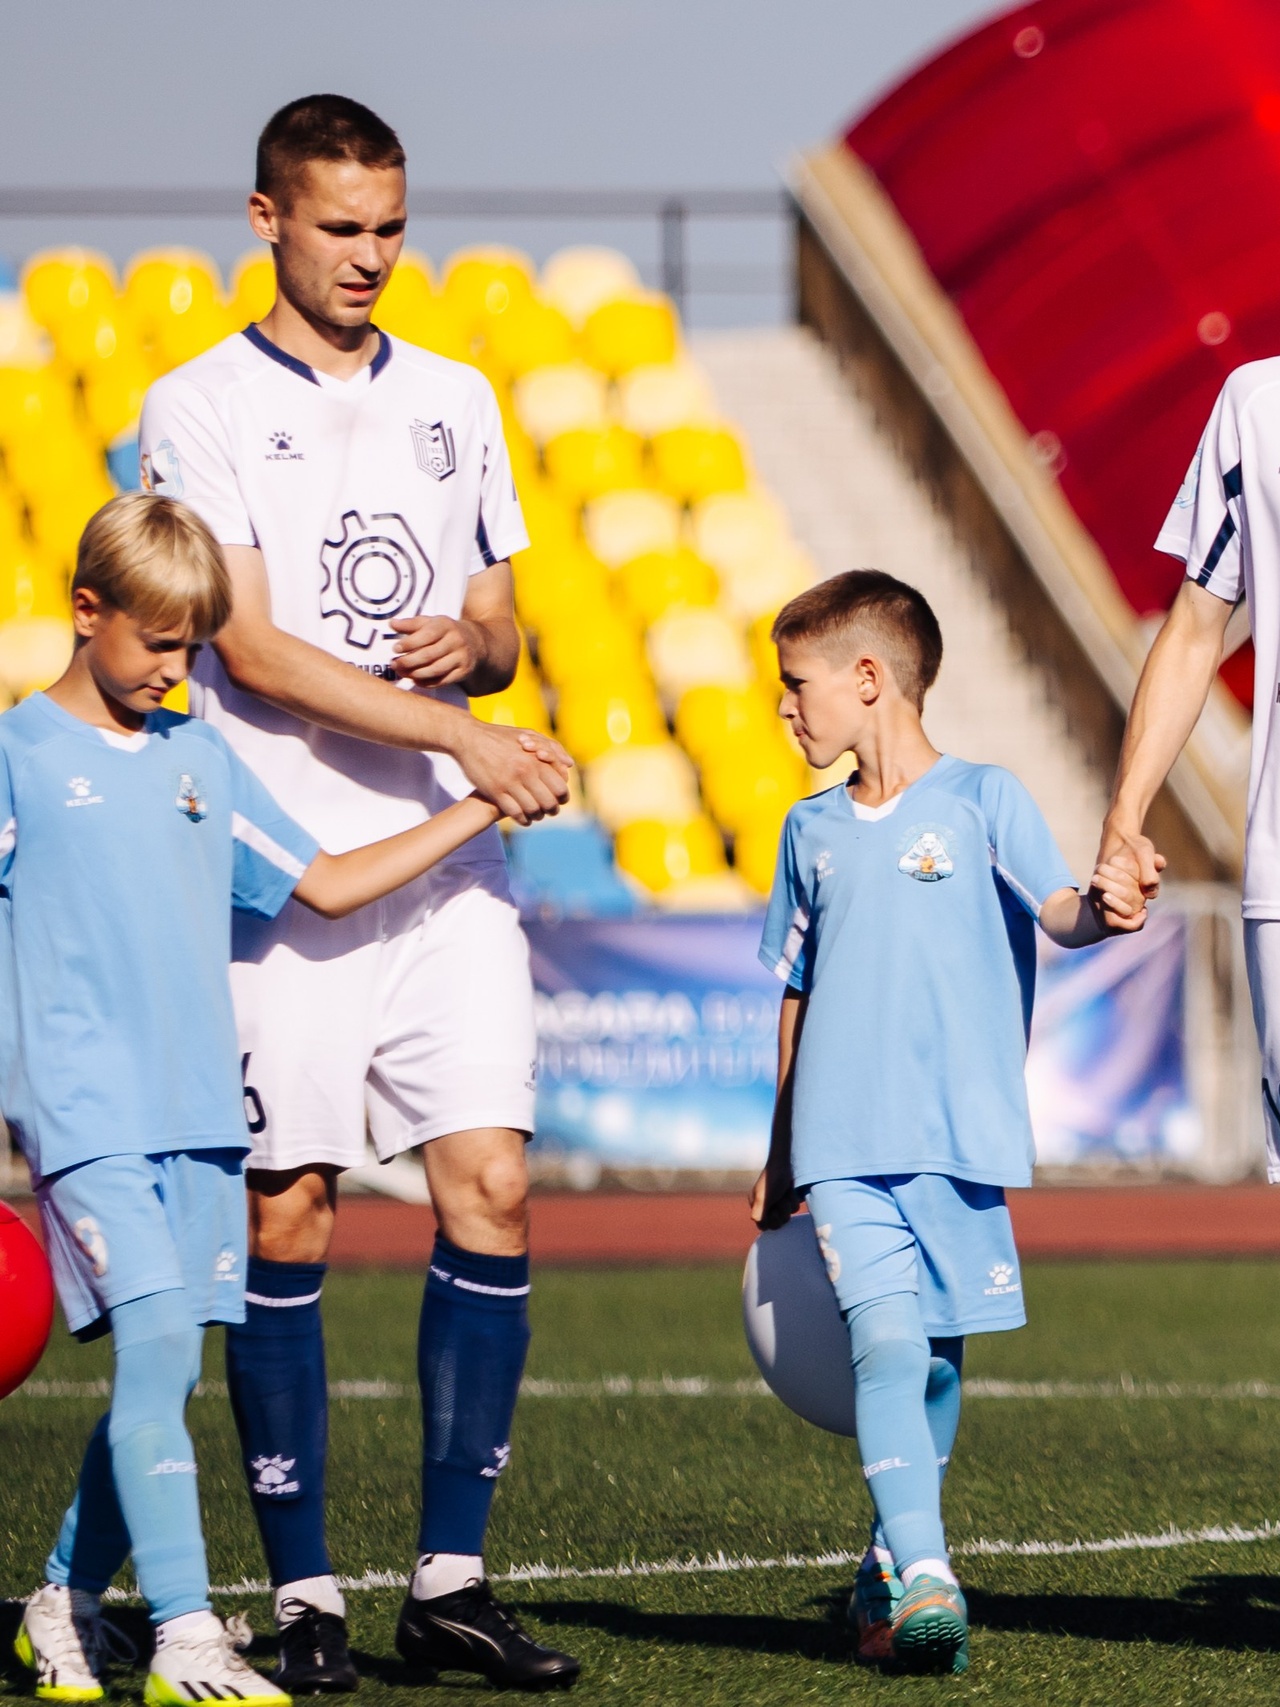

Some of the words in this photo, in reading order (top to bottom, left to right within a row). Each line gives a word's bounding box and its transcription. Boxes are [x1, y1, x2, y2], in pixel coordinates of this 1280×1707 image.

[265, 453, 305, 461] KELME
[984, 1284, 1021, 1296] KELME
[253, 1480, 301, 1495] KELME
